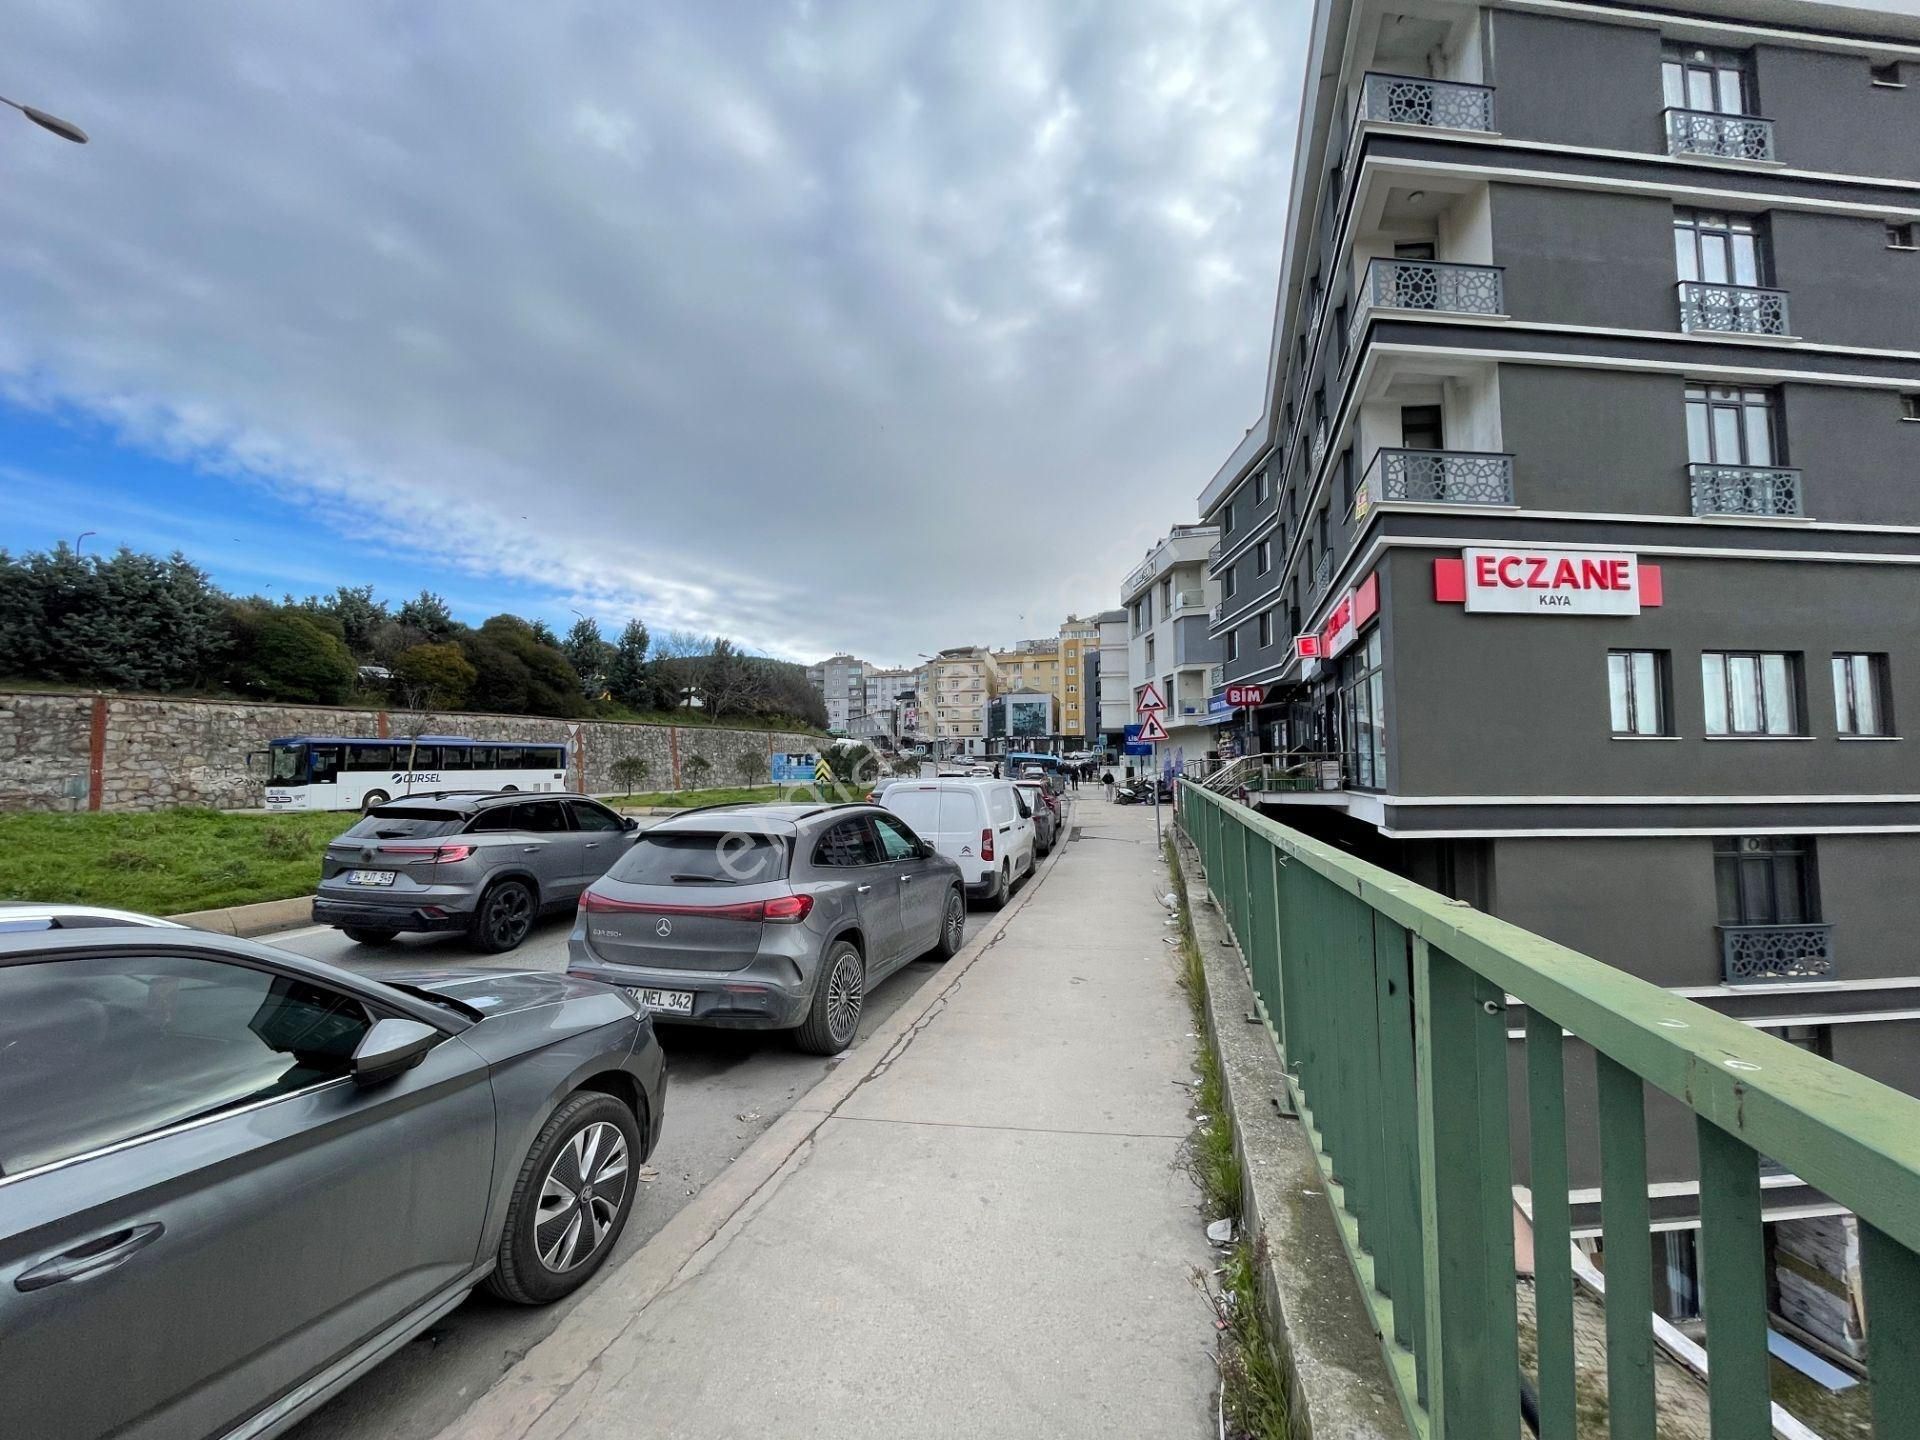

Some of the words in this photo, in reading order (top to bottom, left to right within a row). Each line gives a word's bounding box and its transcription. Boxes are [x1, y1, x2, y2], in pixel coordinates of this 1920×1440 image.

[1475, 556, 1631, 591] ECZANE
[1539, 595, 1571, 606] KAYA
[1302, 639, 1315, 653] E
[1230, 688, 1261, 703] BİM
[641, 989, 664, 1006] NEL
[668, 993, 691, 1009] 342
